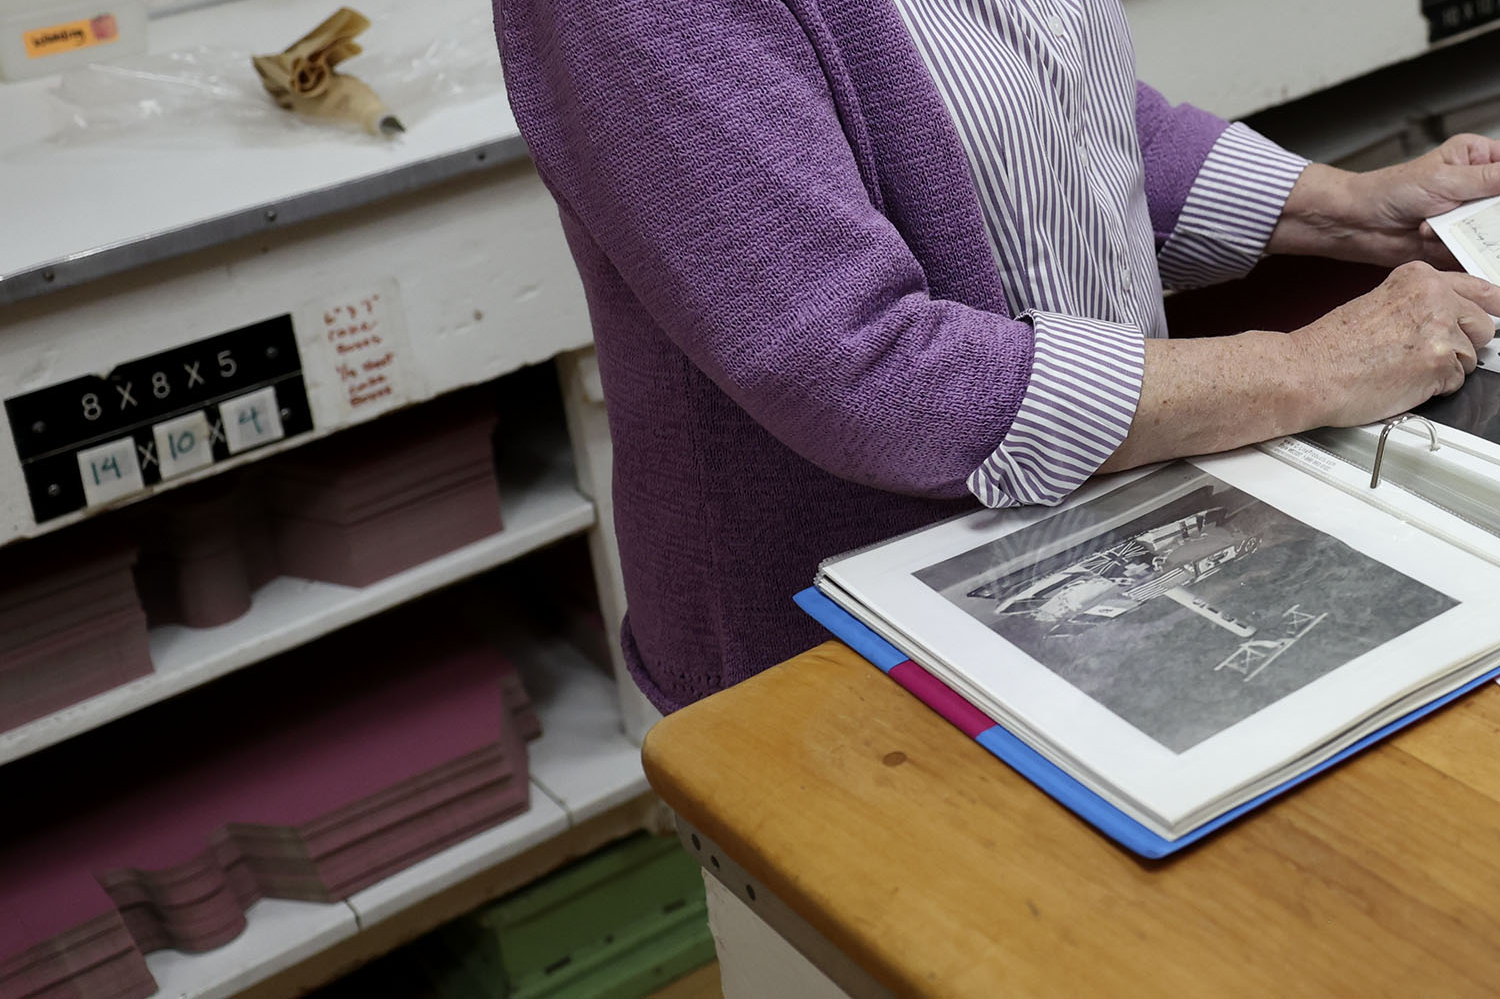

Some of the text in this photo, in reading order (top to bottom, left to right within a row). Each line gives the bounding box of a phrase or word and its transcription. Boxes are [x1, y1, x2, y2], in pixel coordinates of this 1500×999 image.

[81, 350, 238, 421] 8 X 8 X 5
[90, 455, 122, 486] 14
[167, 431, 196, 461] 10
[237, 407, 263, 434] 4
